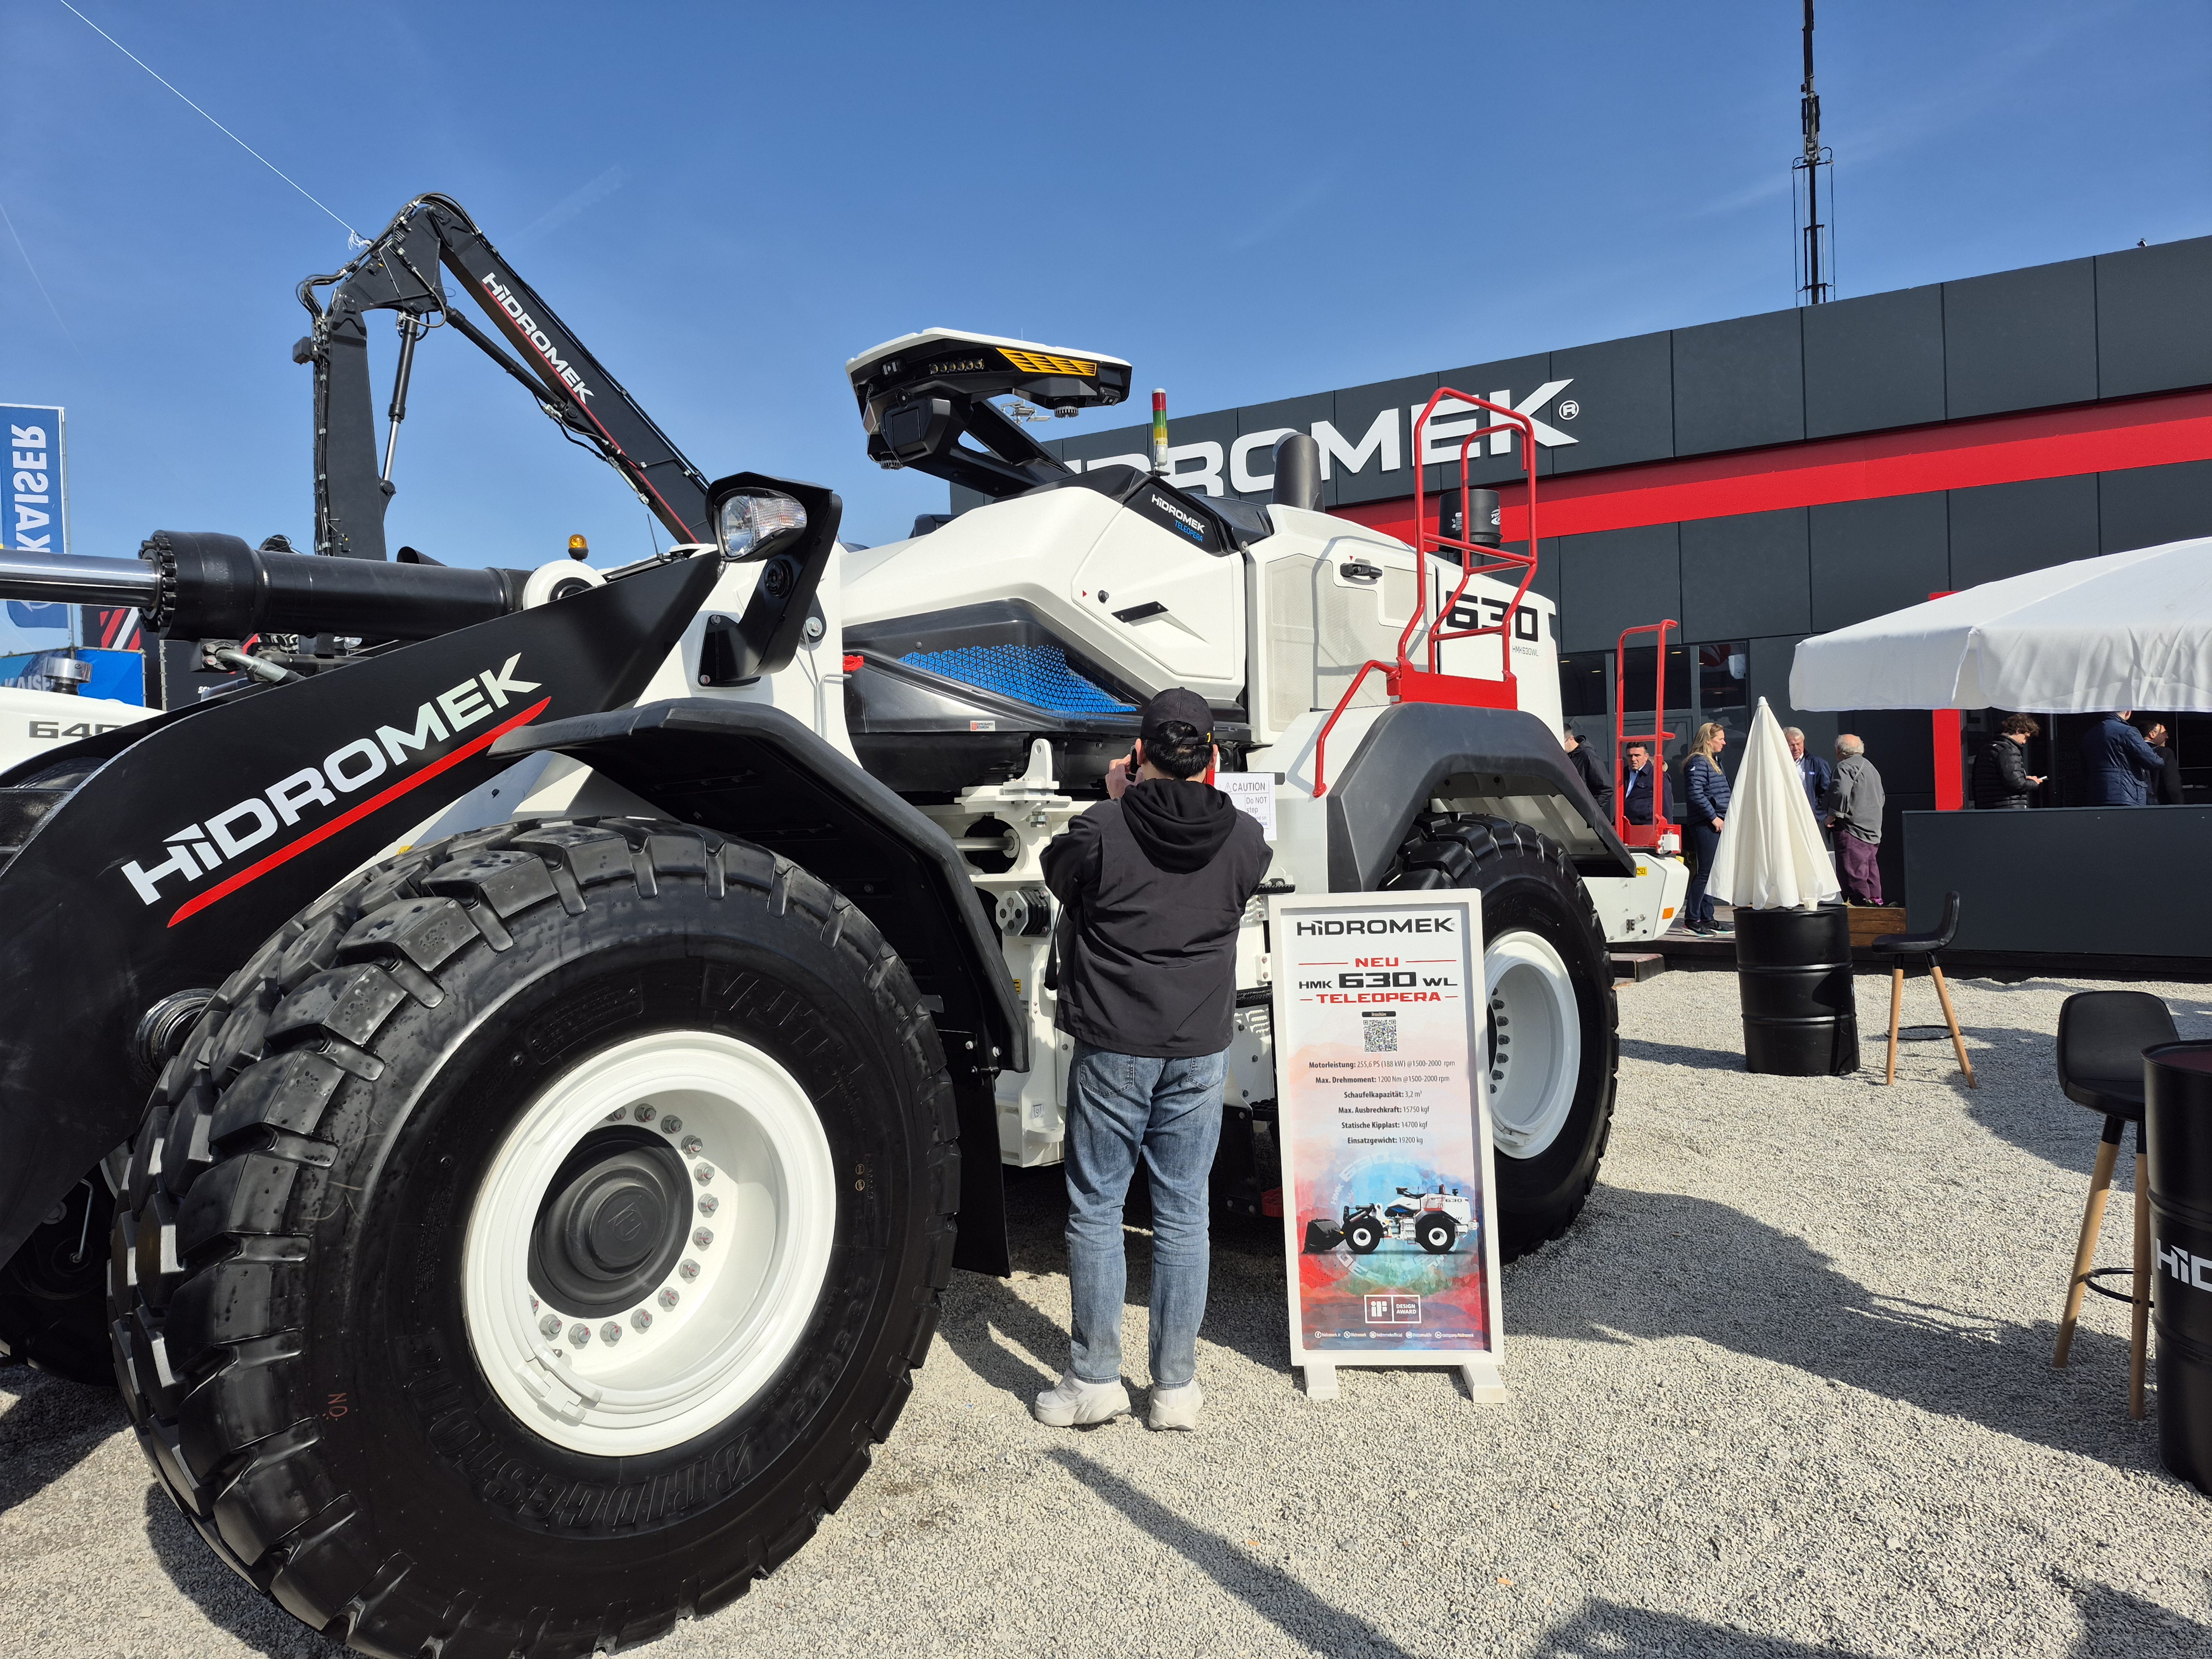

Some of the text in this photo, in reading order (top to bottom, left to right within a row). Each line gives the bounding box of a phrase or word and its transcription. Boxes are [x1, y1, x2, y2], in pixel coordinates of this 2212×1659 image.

[1175, 519, 1203, 543] TELEOPERA
[1446, 590, 1538, 642] 630
[1512, 645, 1539, 657] HMK630WL
[1232, 782, 1265, 792] CAUTION
[1355, 957, 1399, 968] NEU
[1298, 971, 1458, 989] HMK 630 WL
[1316, 992, 1442, 1004] TELEOPERA
[1309, 1061, 1356, 1070] Motorleistung:
[1381, 1060, 1394, 1068] (188
[1394, 1060, 1406, 1068] kW)
[1406, 1060, 1442, 1068] @1500-2000
[1402, 1075, 1438, 1083] @1500-2000
[1344, 1091, 1404, 1100] Schaufelkapazität:
[1405, 1091, 1414, 1099] 3,2
[1354, 1105, 1402, 1114] Ausbrechkraft:
[1421, 1105, 1430, 1115] kgf
[1371, 1121, 1400, 1130] Kipplast:
[1418, 1120, 1428, 1130] kgf
[1347, 1136, 1397, 1146] Einsatzgewicht:
[1416, 1136, 1423, 1145] kg
